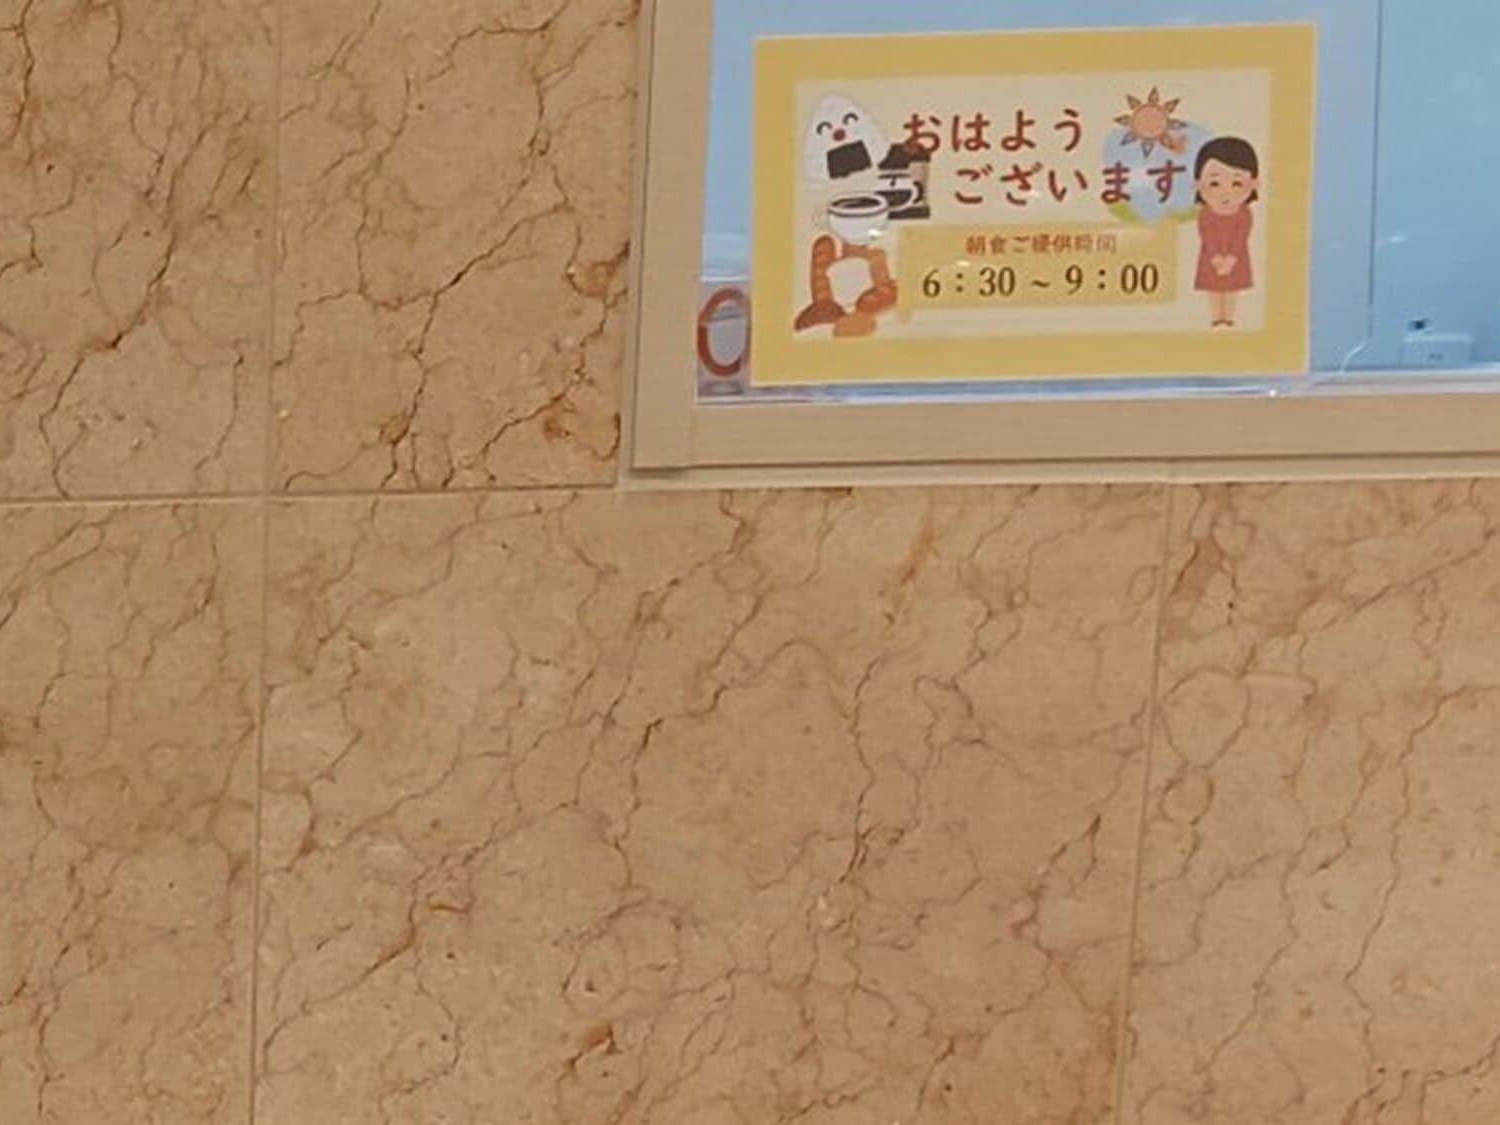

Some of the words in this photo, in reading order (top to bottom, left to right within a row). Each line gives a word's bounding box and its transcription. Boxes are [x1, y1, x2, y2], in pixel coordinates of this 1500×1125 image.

[903, 109, 1083, 153] おはよう
[954, 160, 1187, 204] ございます
